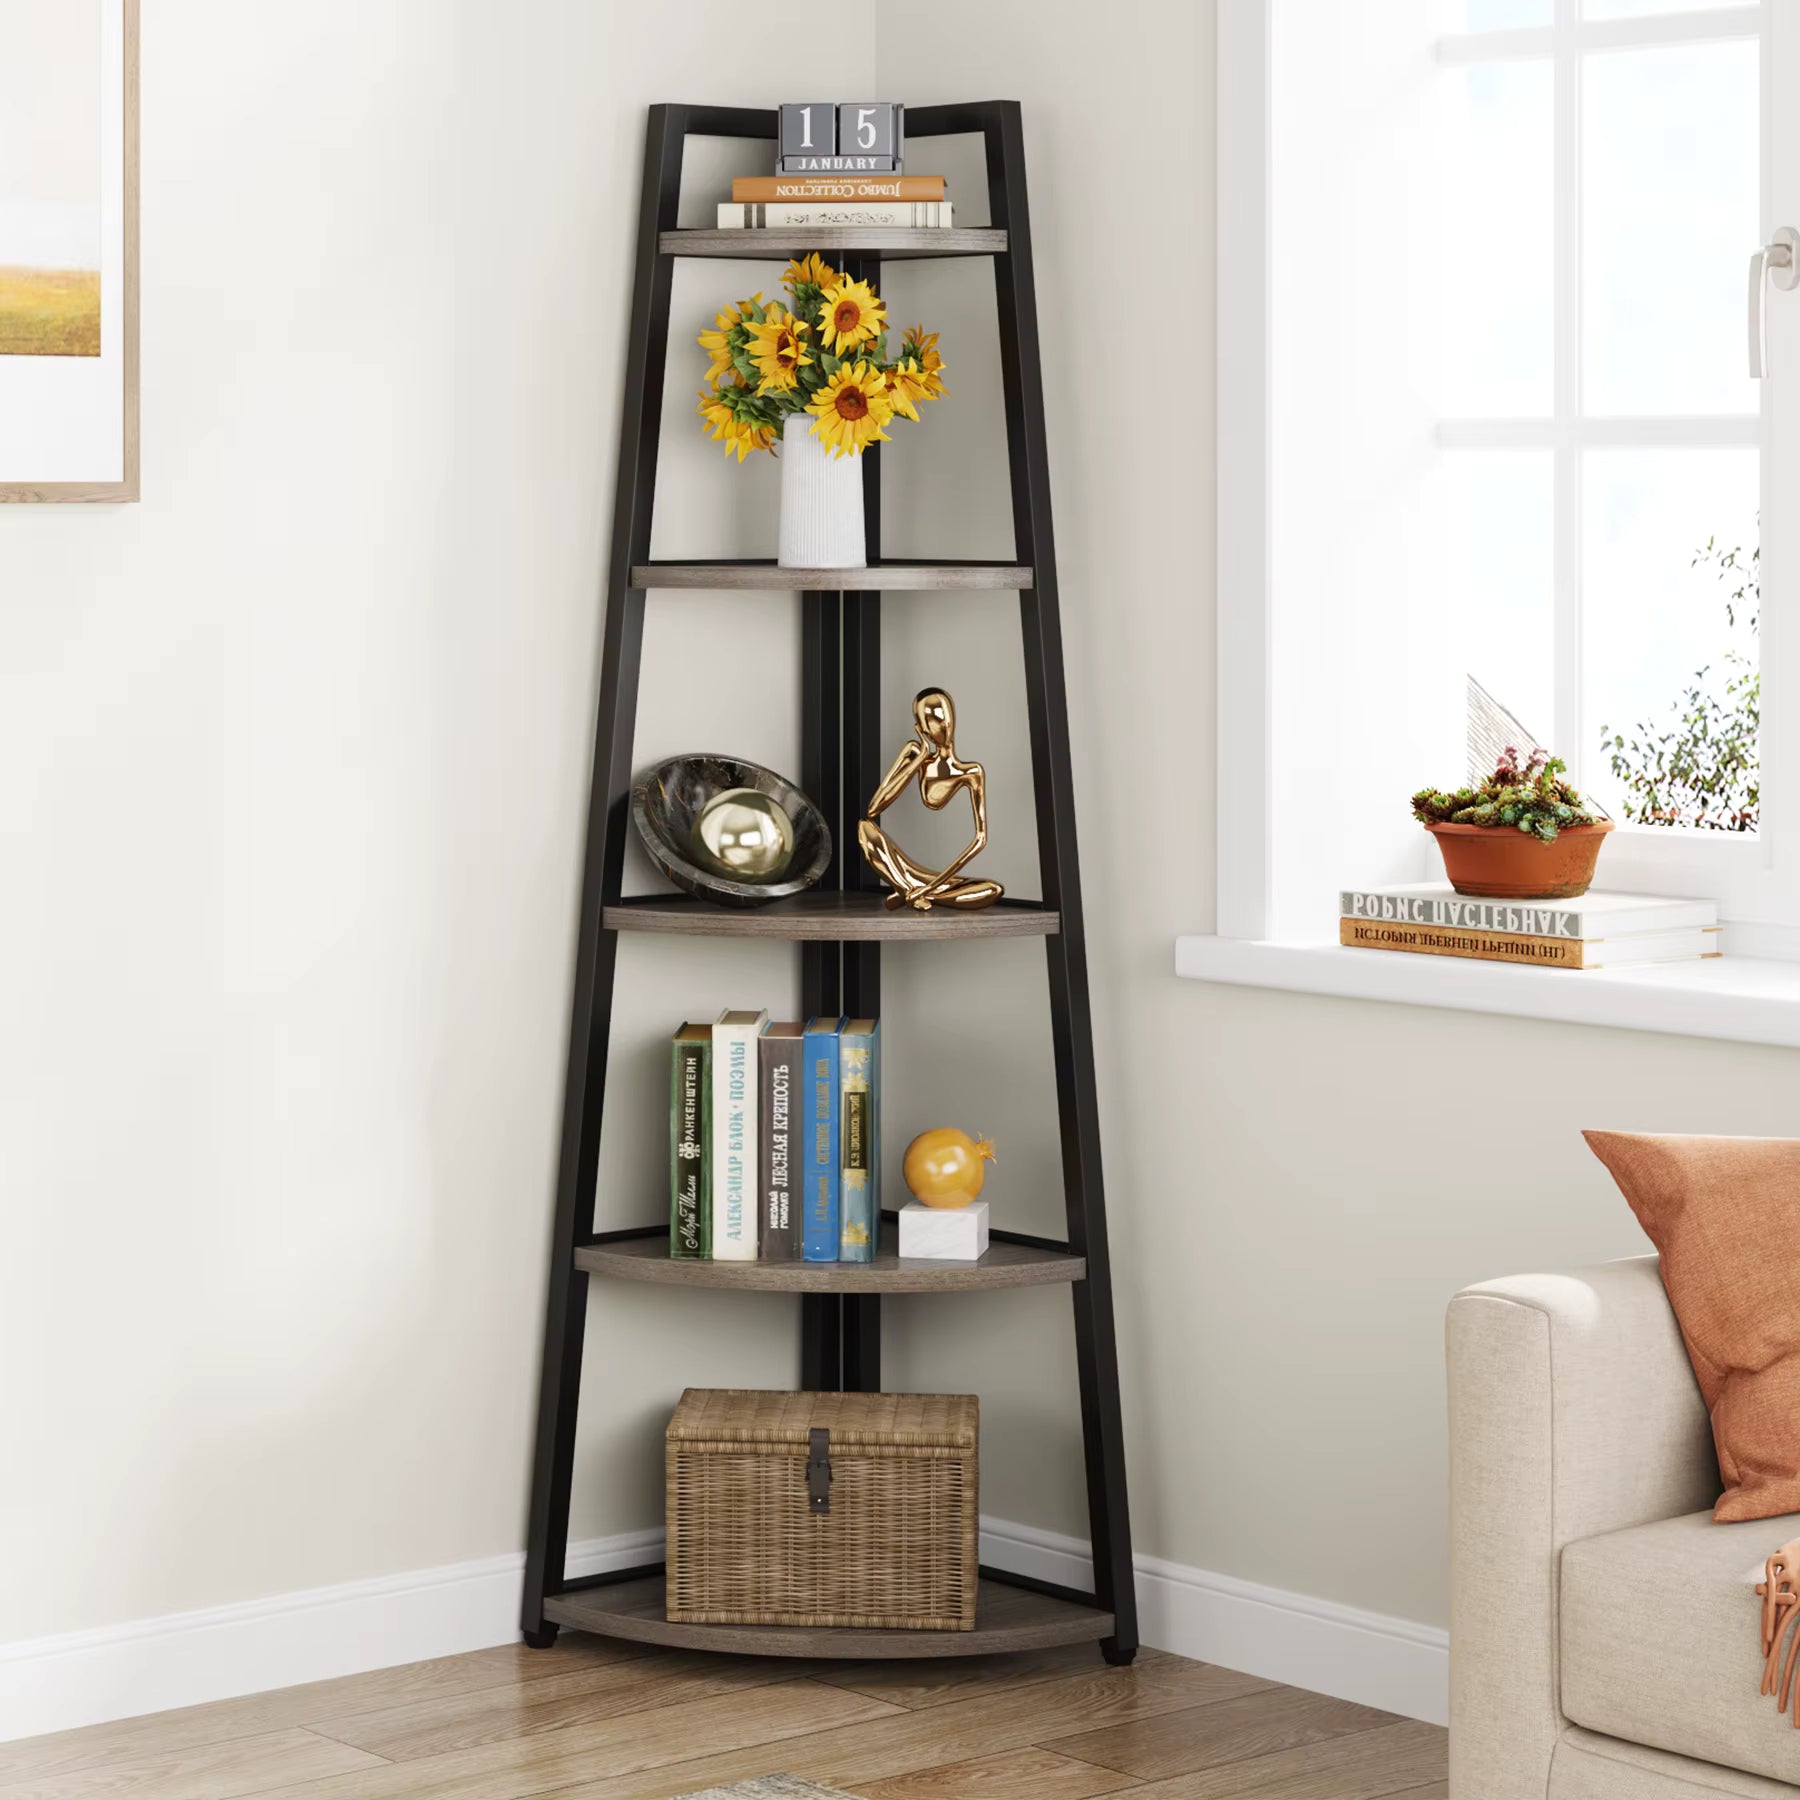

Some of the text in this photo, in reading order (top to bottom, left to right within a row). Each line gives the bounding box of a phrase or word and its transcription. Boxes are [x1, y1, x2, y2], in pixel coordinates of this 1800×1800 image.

[799, 107, 877, 149] 1 5
[798, 157, 878, 170] JANUARY
[776, 181, 901, 198] JUMBO COLLECTION
[726, 1041, 745, 1241] АЛЕКСАНДР БЛОК ПОЭМЫ
[772, 1064, 789, 1187] ЛЕСНАЯ КРЕПОСТЬ
